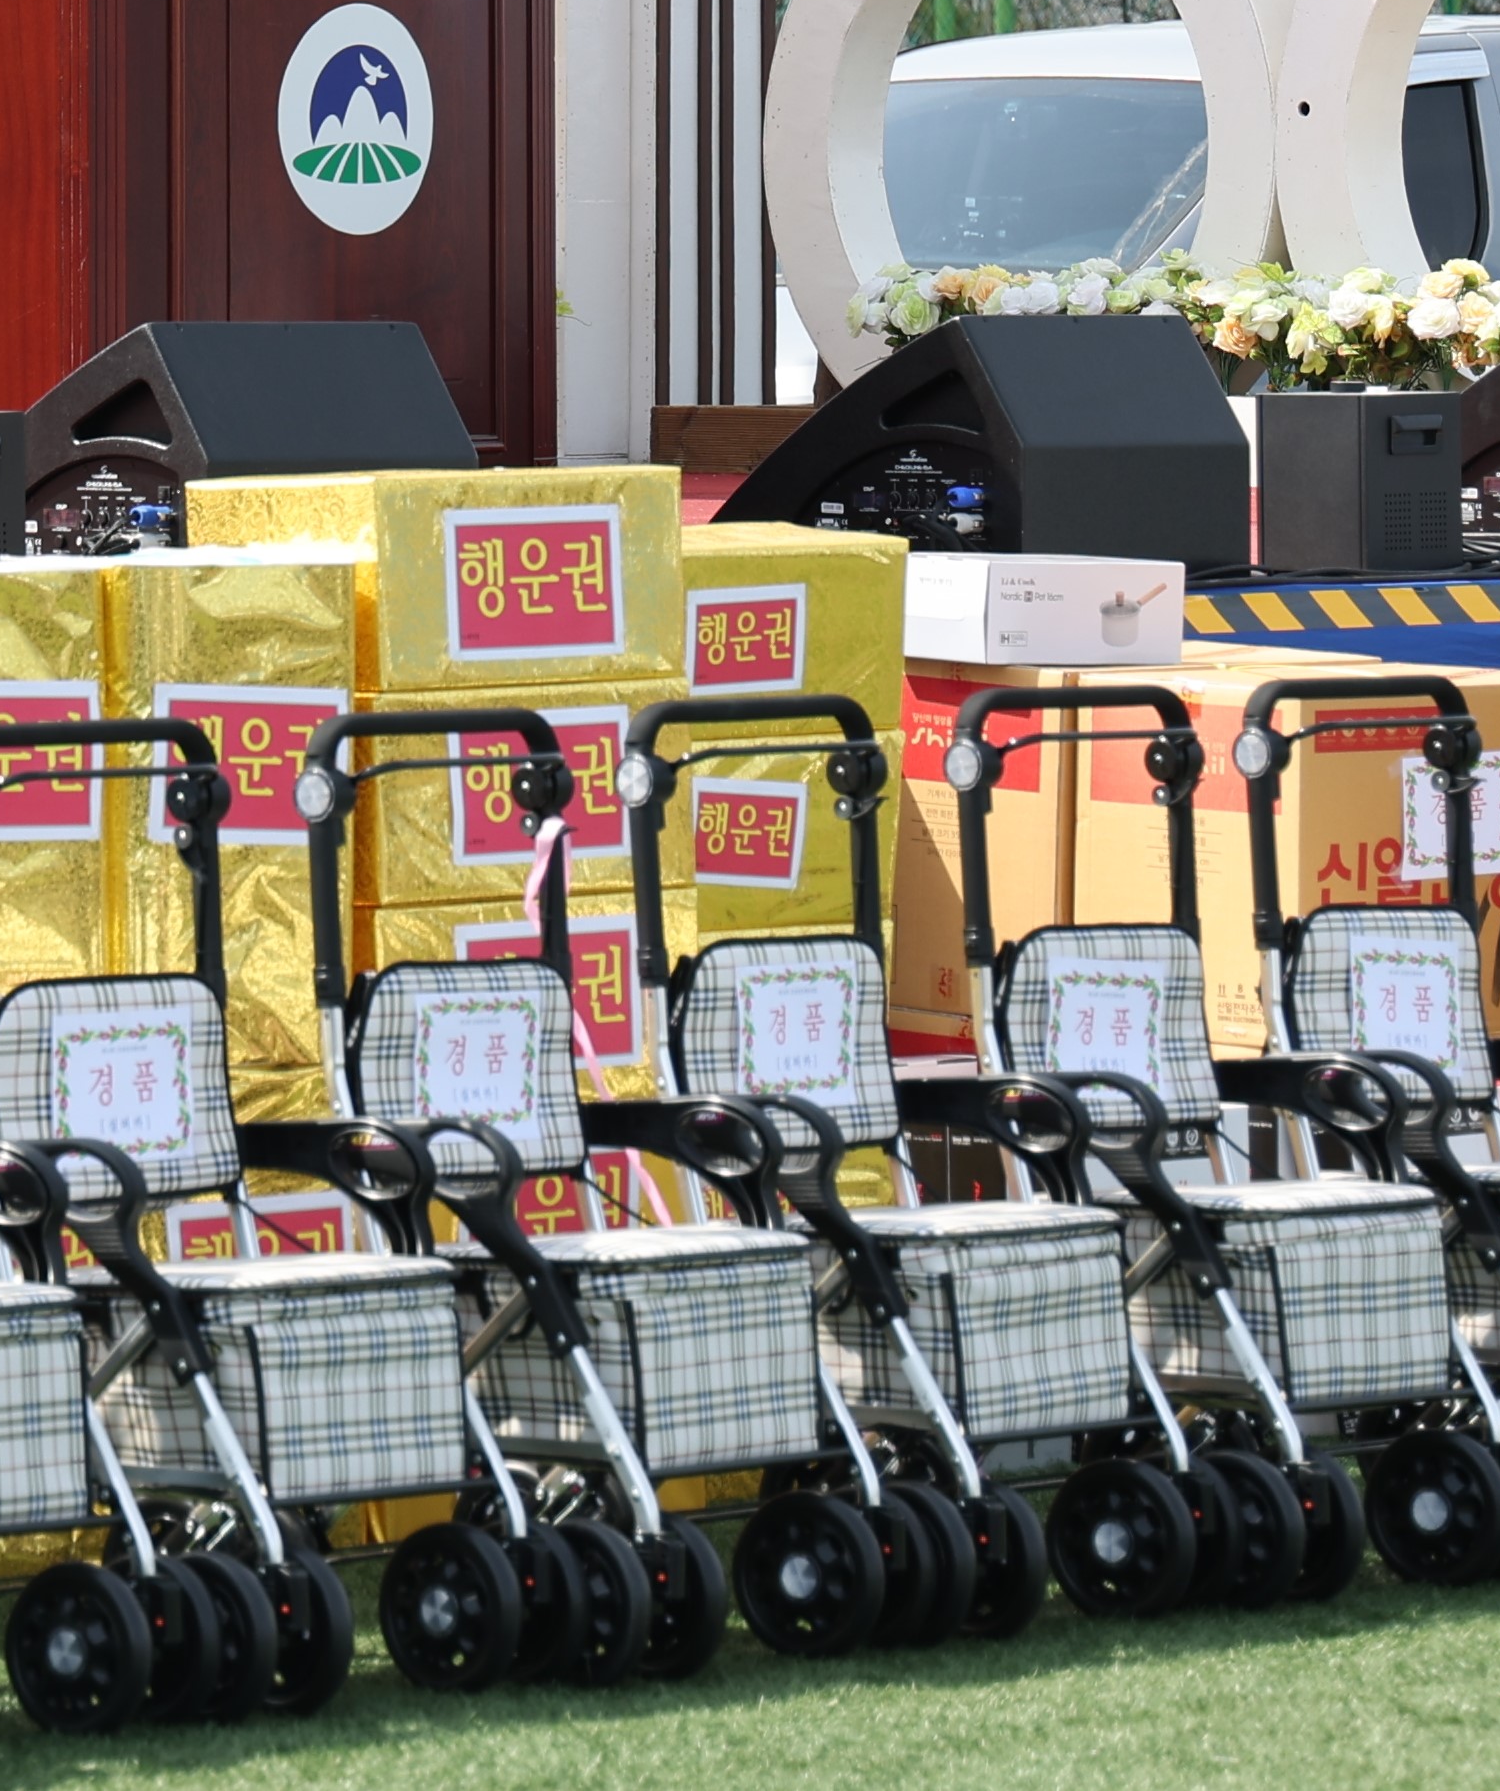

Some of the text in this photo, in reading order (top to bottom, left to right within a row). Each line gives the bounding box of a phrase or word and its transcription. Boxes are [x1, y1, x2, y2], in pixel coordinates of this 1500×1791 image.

[458, 533, 608, 619] 행운권
[1001, 591, 1023, 601] Nordic
[697, 607, 792, 666] 행운권
[465, 736, 618, 824] 행권
[699, 801, 793, 858] 행운권
